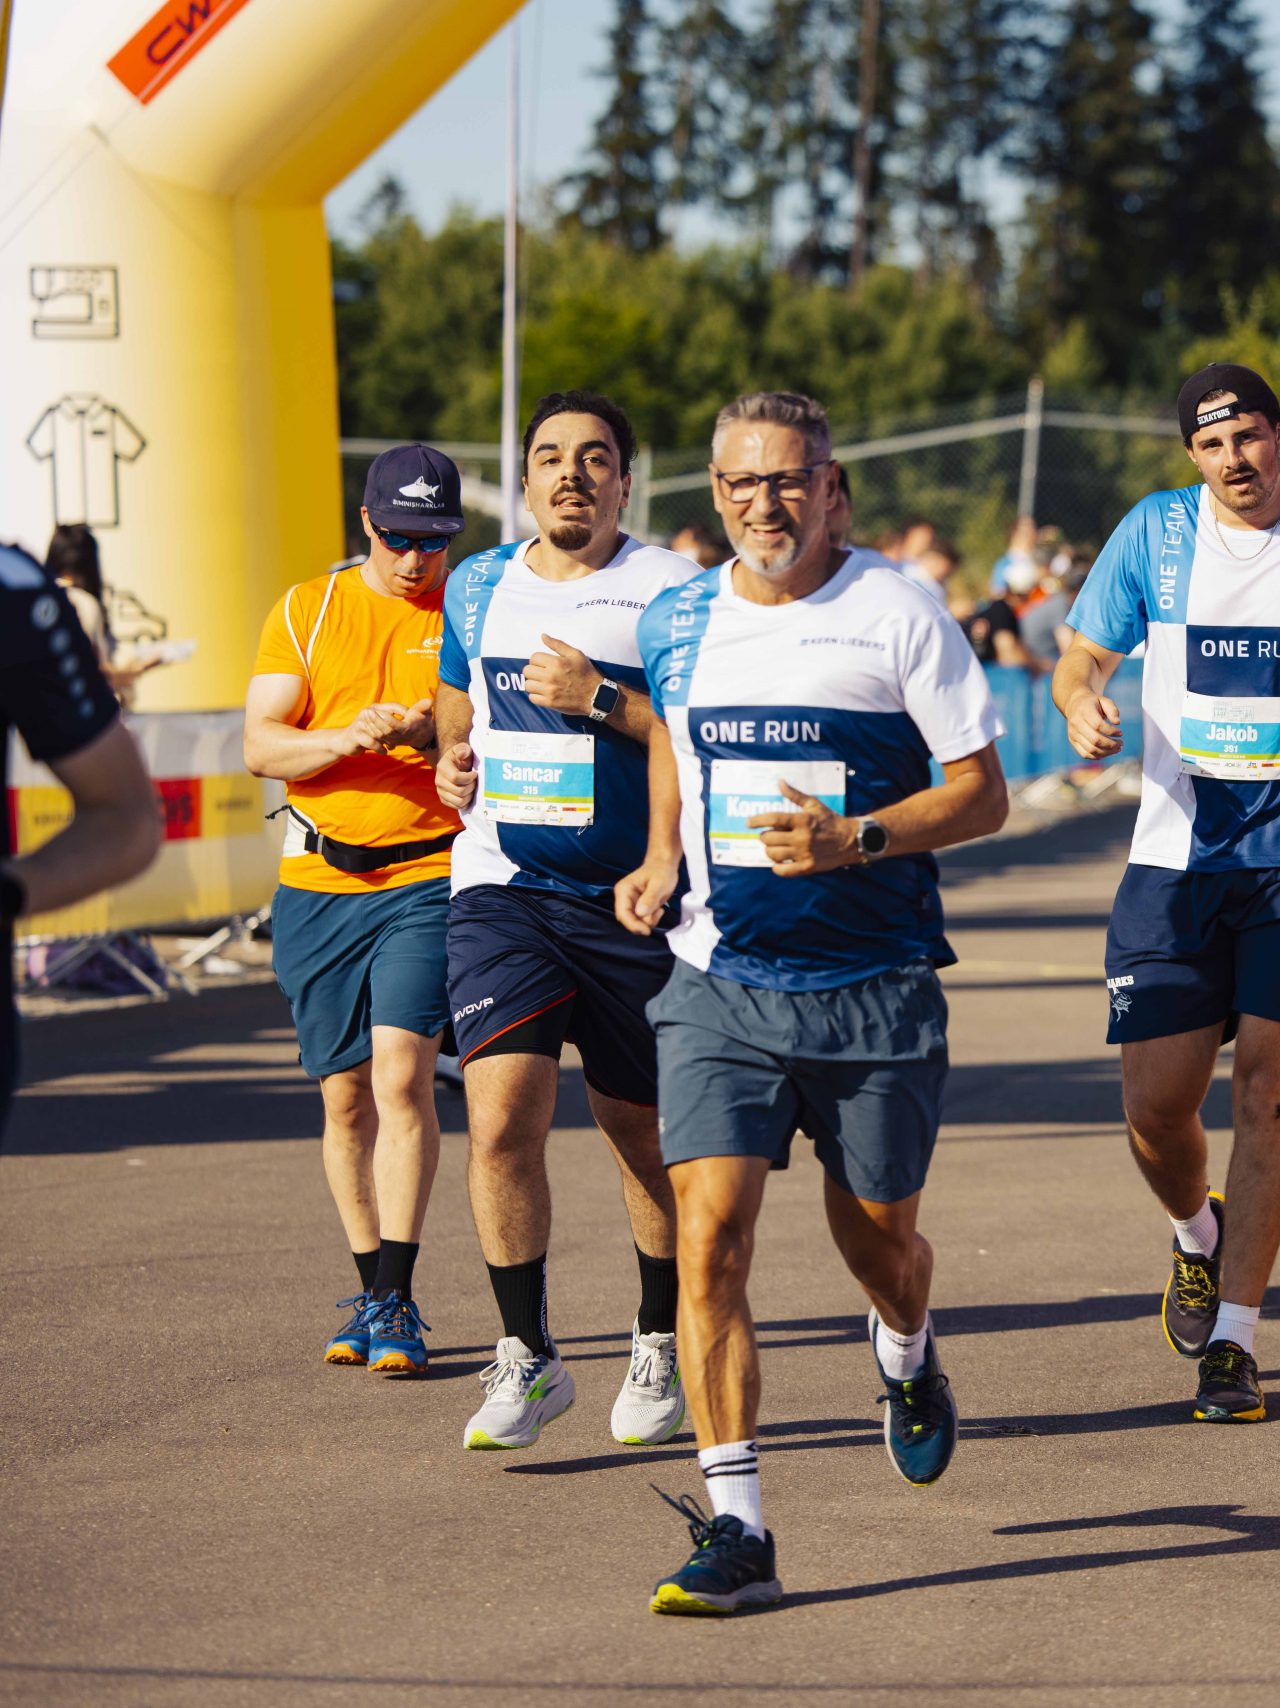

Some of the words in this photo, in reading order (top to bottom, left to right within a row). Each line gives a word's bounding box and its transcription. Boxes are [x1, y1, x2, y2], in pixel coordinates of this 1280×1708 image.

[146, 0, 210, 65] CW
[1196, 407, 1231, 425] SENATORS
[1162, 503, 1186, 557] TEAM
[466, 549, 502, 597] TEAM
[1159, 564, 1178, 610] ONE
[585, 598, 609, 606] KERN
[611, 599, 647, 610] LIEBER
[670, 581, 708, 642] TEAM
[464, 601, 480, 647] ONE
[840, 637, 887, 651] LIEBERS
[1201, 639, 1250, 658] ONE
[667, 643, 690, 692] ONE
[496, 672, 526, 691] ON
[700, 720, 756, 744] ONE
[764, 720, 820, 743] RUN
[1205, 724, 1258, 742] Jakob
[1223, 744, 1239, 753] 391
[502, 762, 563, 783] Sancar
[522, 785, 539, 795] 315
